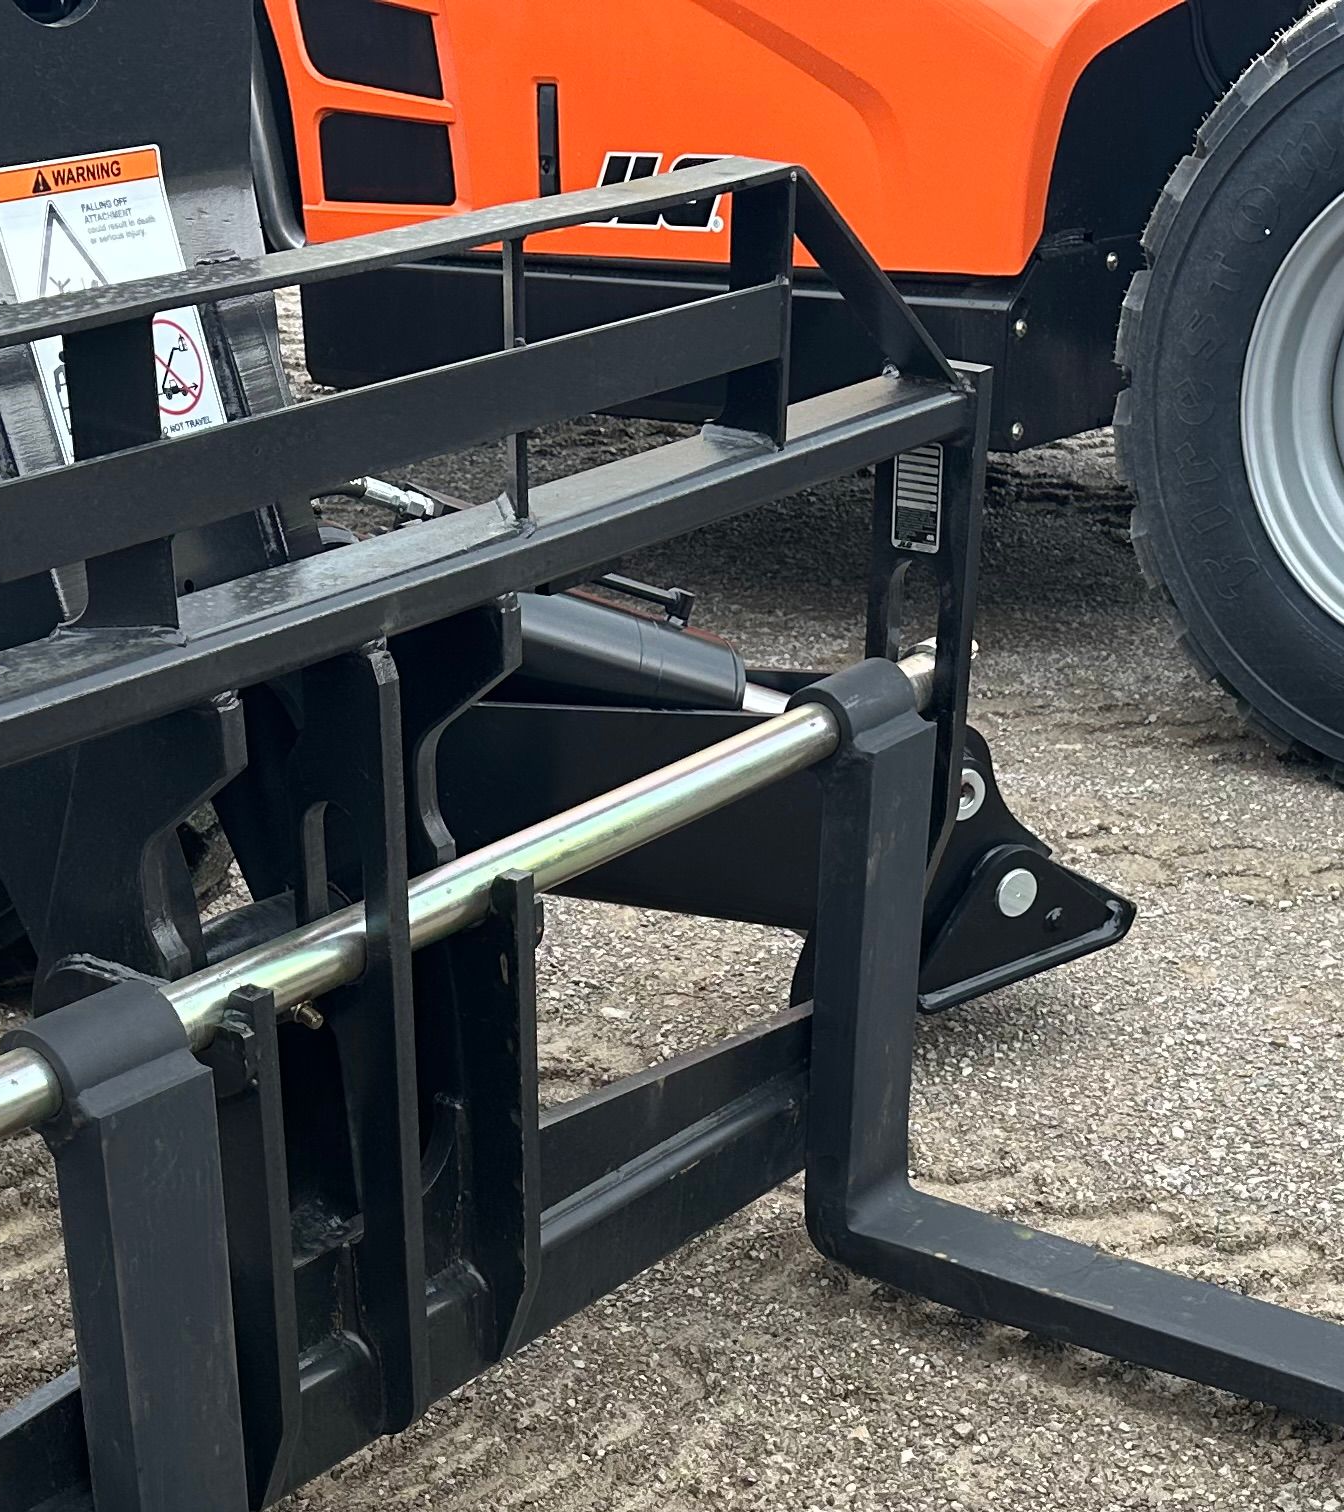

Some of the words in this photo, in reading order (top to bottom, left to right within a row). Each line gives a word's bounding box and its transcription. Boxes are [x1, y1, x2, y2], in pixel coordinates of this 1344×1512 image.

[52, 160, 121, 187] WARNING
[81, 199, 112, 213] FALLING
[113, 196, 127, 207] OFF
[85, 208, 132, 224] ATTACHMENT
[88, 223, 106, 234] could
[108, 220, 127, 230] result
[137, 214, 156, 226] death
[99, 233, 125, 243] serious
[170, 421, 184, 433] NOT
[185, 415, 213, 428] TRAVEL
